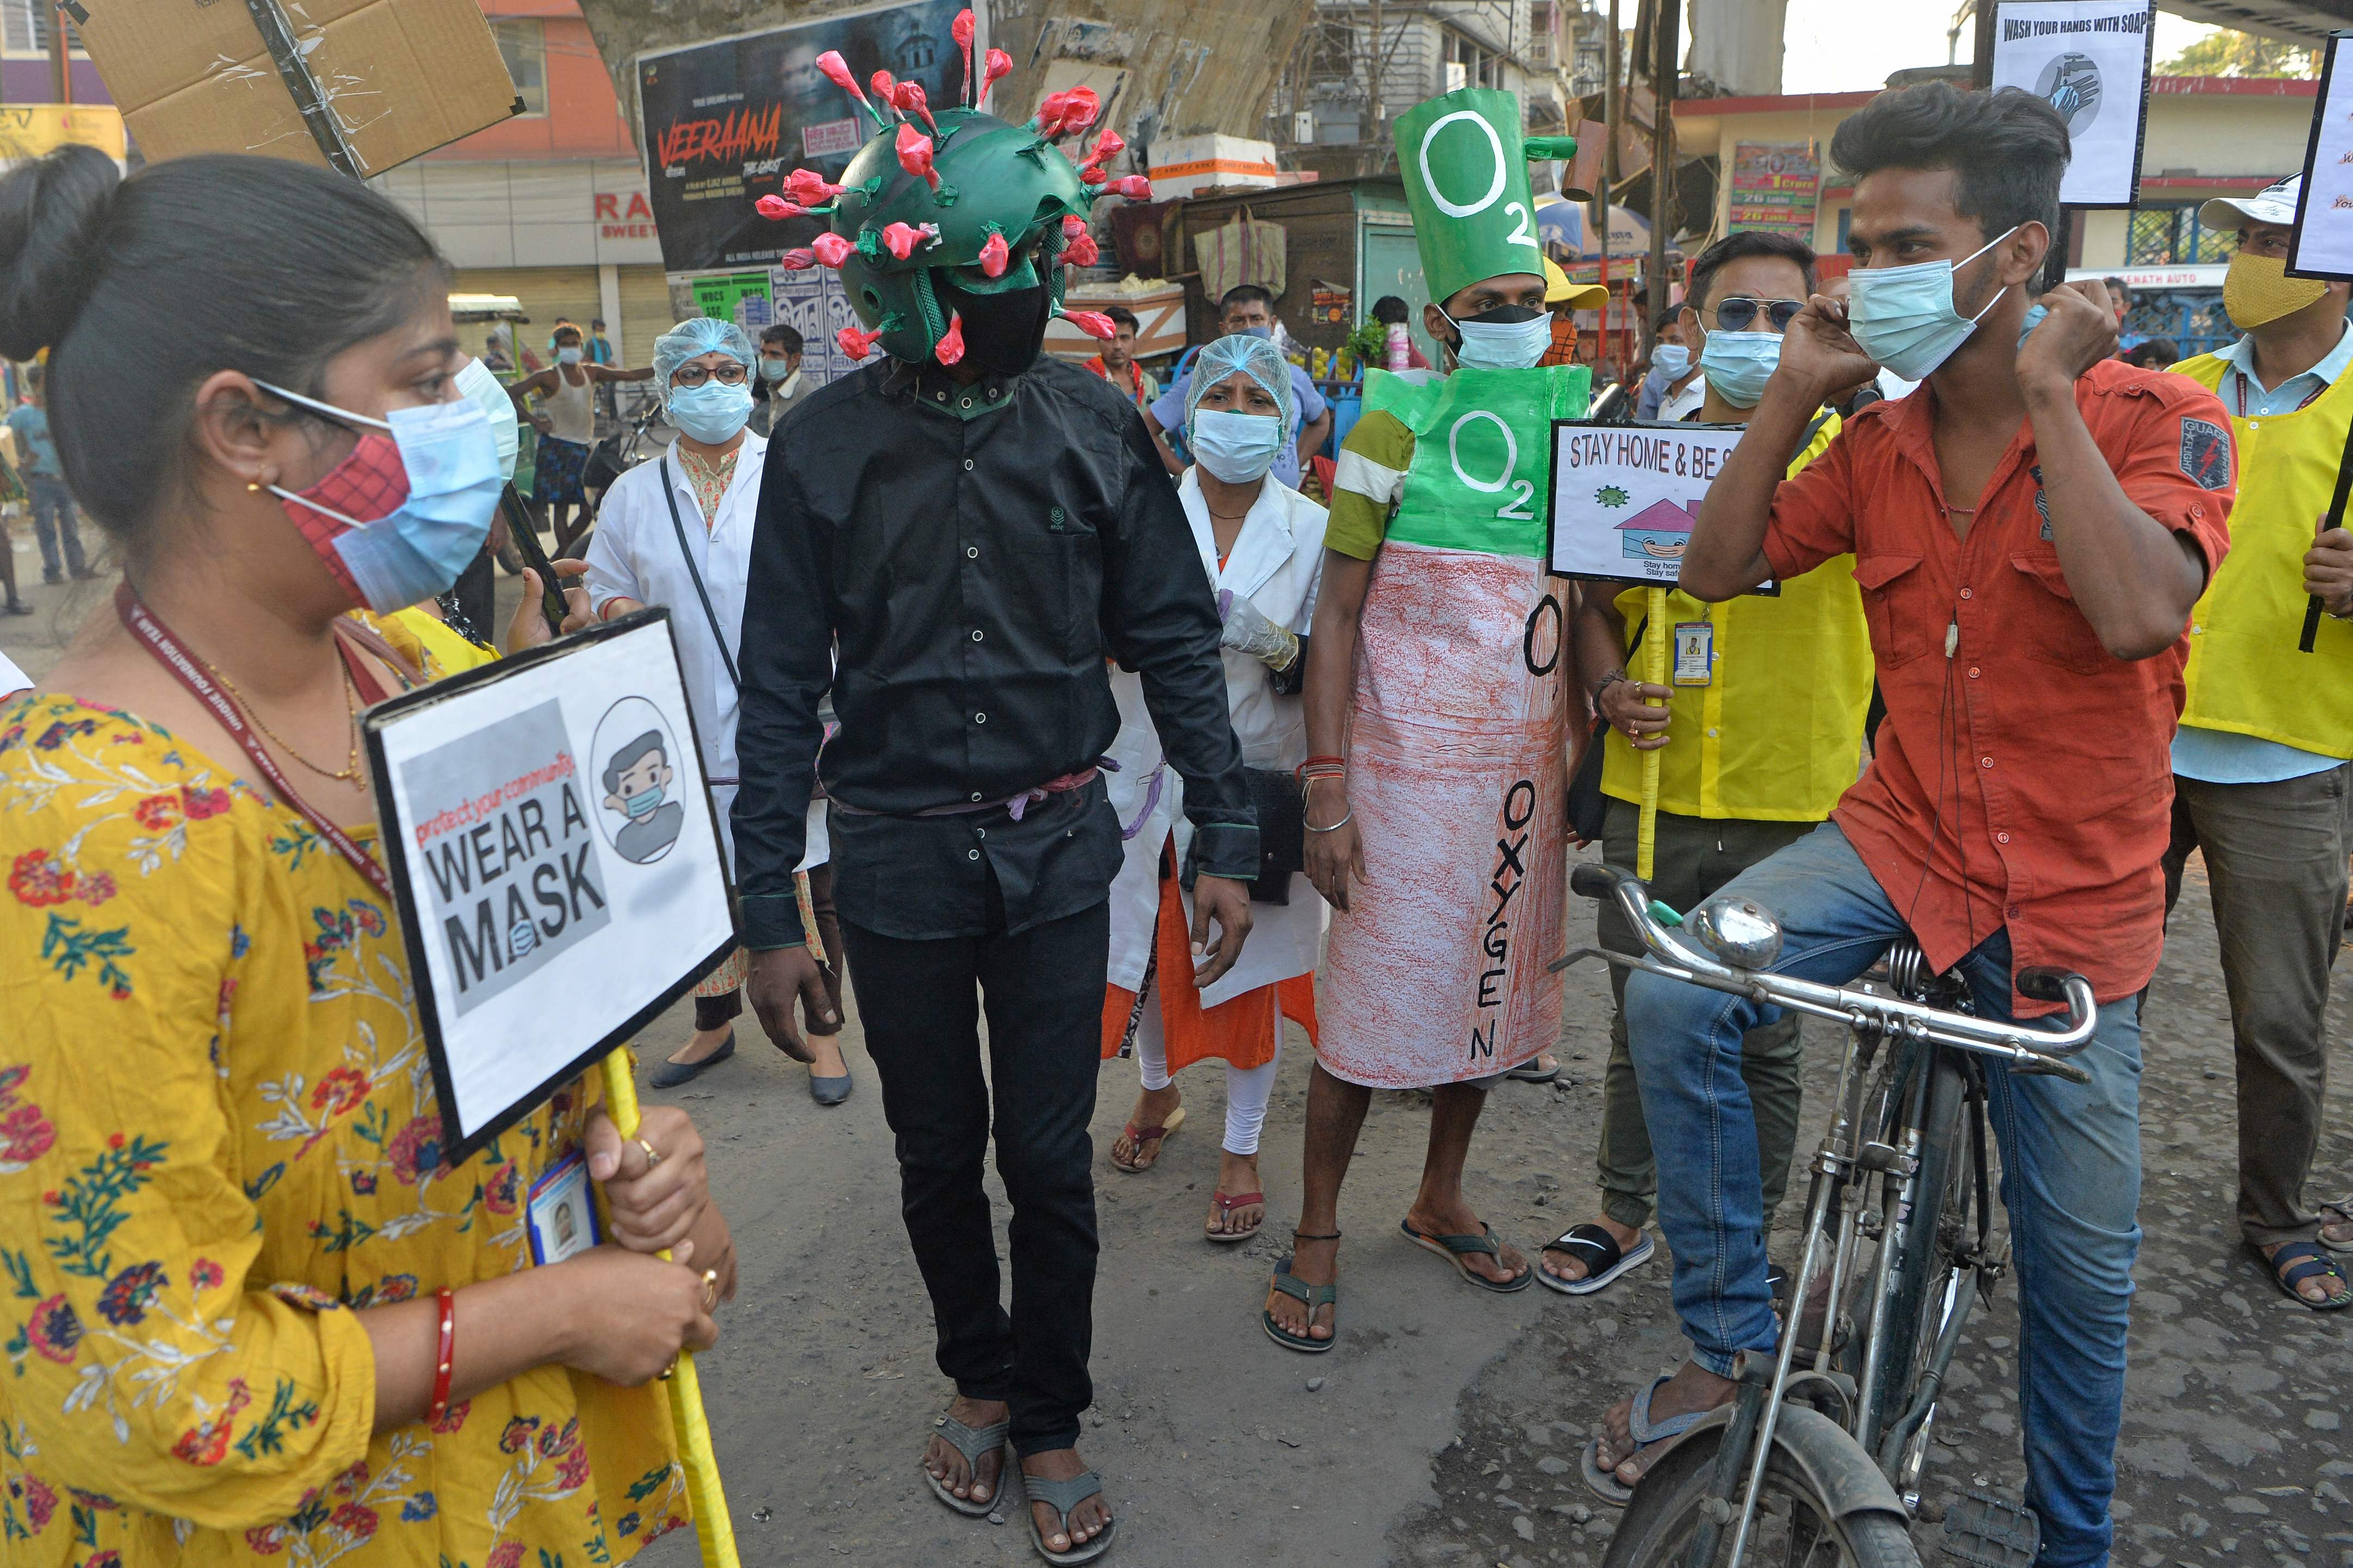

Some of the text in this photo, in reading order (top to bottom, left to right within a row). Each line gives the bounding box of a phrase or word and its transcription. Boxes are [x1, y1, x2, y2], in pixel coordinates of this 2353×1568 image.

[2004, 11, 2147, 42] WASH YOUR HANDS WITH SOAP
[658, 96, 782, 169] VEERAANA
[2167, 274, 2197, 284] AUTO
[1570, 433, 1613, 468] STAY
[1617, 433, 1671, 473] HOME
[1675, 442, 1687, 477] &
[1692, 445, 1717, 481] BE
[2182, 441, 2193, 472] FLIGHT
[1643, 561, 1661, 570] Stay
[1646, 568, 1679, 578] Stay saf
[137, 617, 244, 731] UNIQUE FOUNDATION TEAM
[415, 797, 472, 850] protect
[471, 788, 503, 823] your
[425, 782, 589, 904] WEAR A
[444, 839, 605, 994] MASK
[1470, 779, 1535, 1061] OXYGEN
